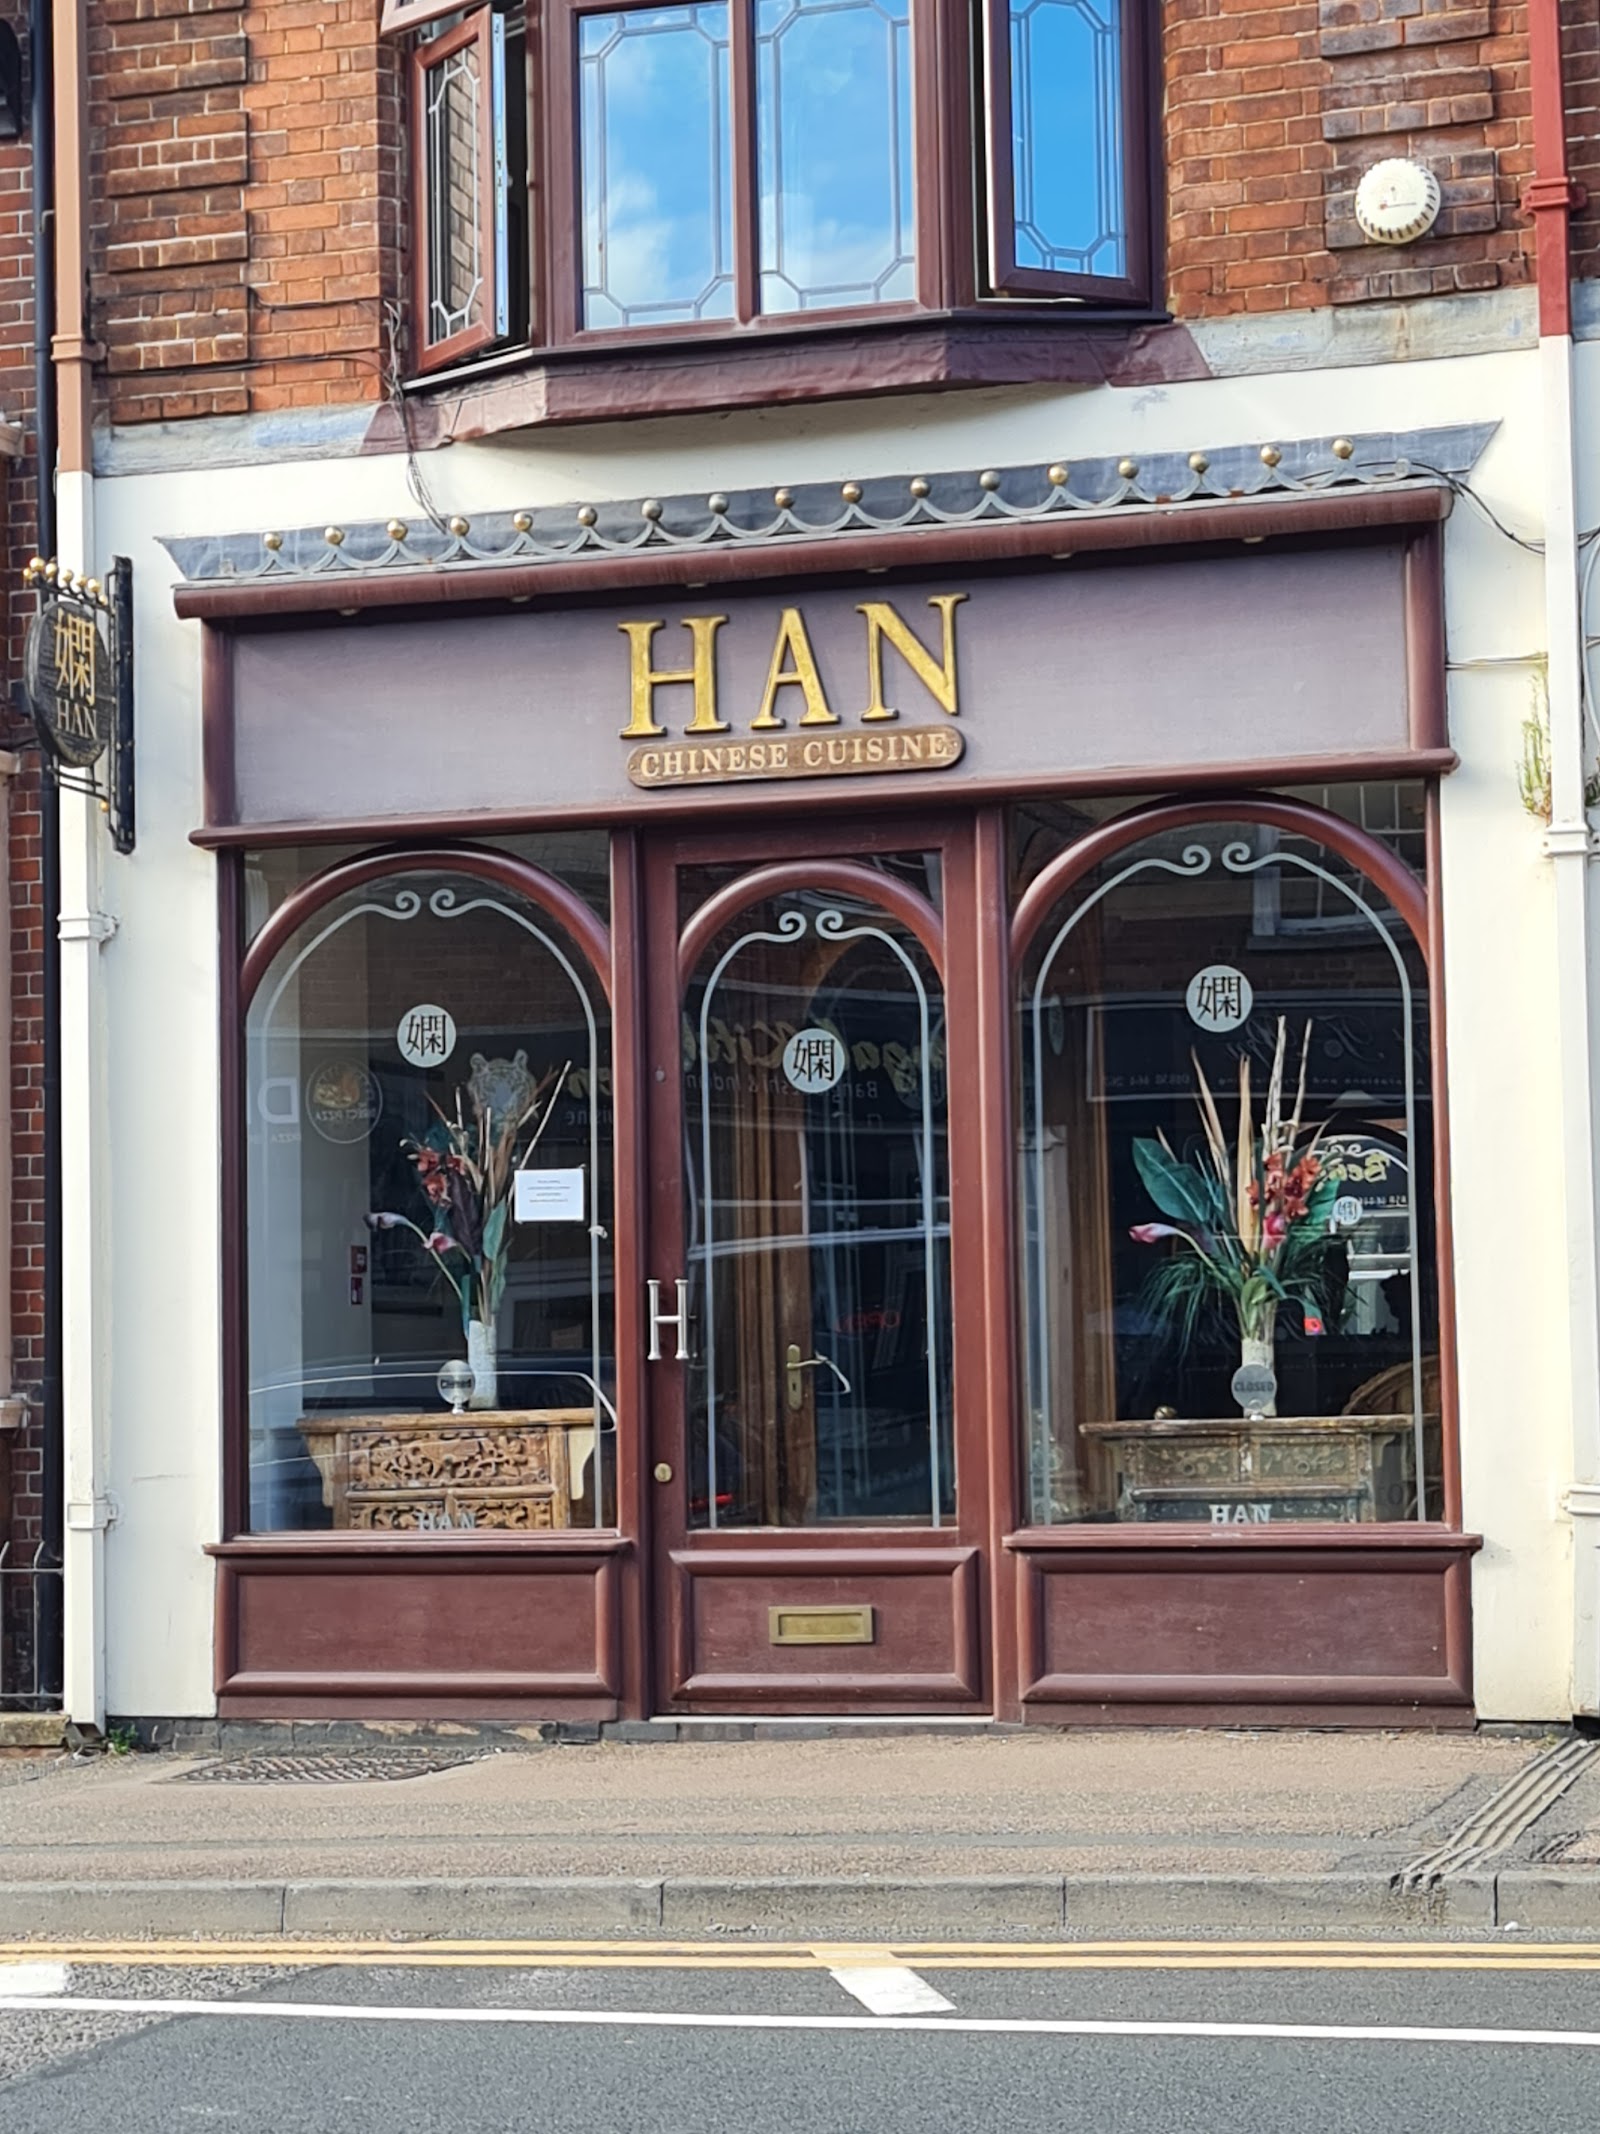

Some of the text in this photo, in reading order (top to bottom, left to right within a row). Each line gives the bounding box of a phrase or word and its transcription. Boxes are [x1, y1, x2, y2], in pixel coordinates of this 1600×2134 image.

[617, 592, 969, 740] HAN
[56, 697, 98, 740] HAN
[640, 732, 948, 778] CHINESE CUISINE
[1195, 974, 1243, 1022] 嫻
[405, 1012, 448, 1059] 嫻
[792, 1037, 836, 1083] 嫻
[1233, 1380, 1275, 1393] CLOSED
[1208, 1502, 1273, 1525] HAN
